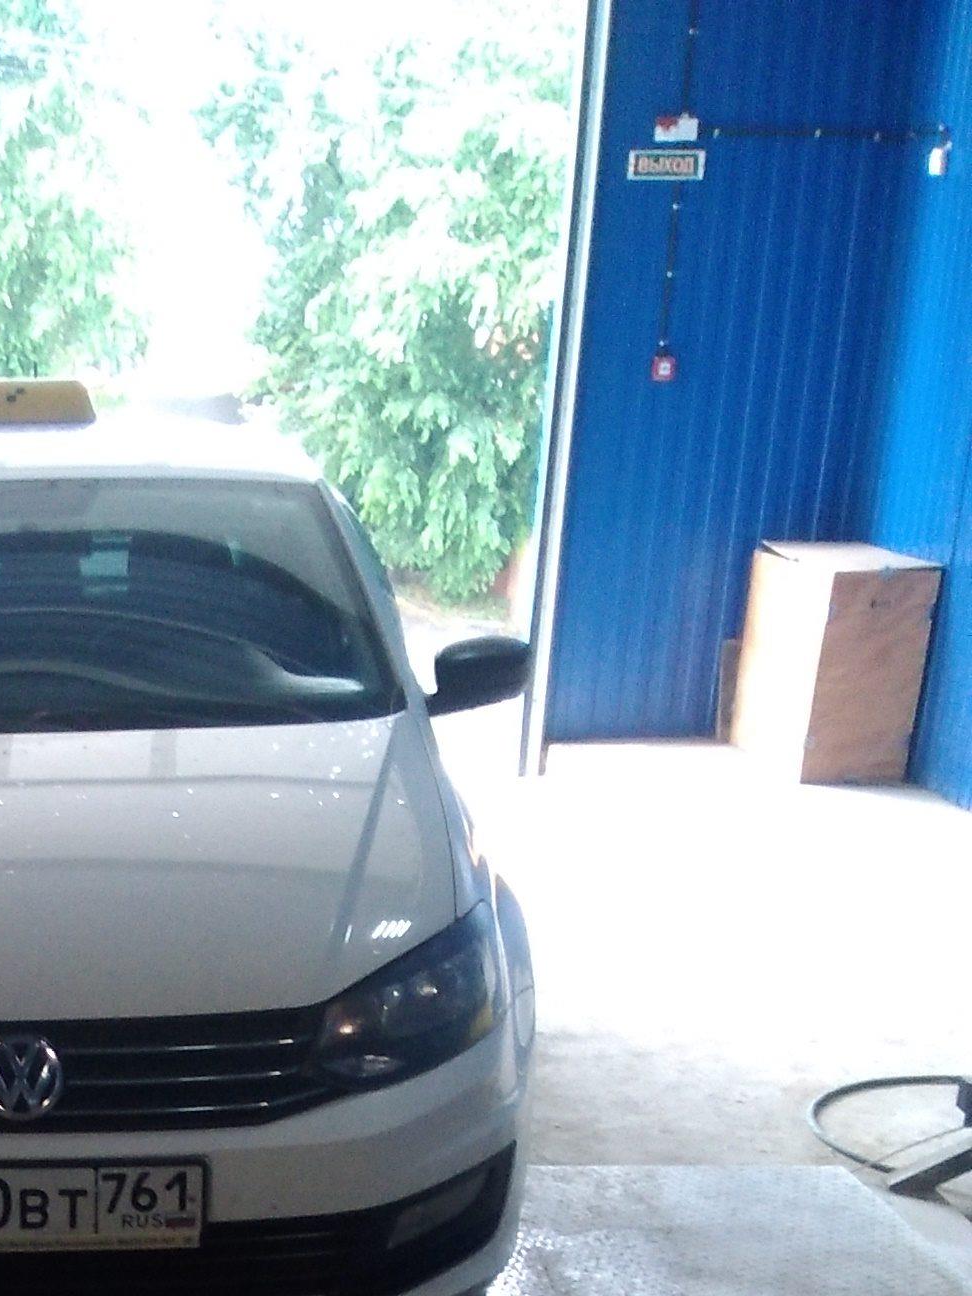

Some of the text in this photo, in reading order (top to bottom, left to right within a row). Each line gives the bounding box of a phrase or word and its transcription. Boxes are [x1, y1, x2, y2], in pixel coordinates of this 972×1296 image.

[637, 155, 695, 173] ВЫХОД
[101, 1170, 188, 1214] 761
[121, 1213, 164, 1229] RUS
